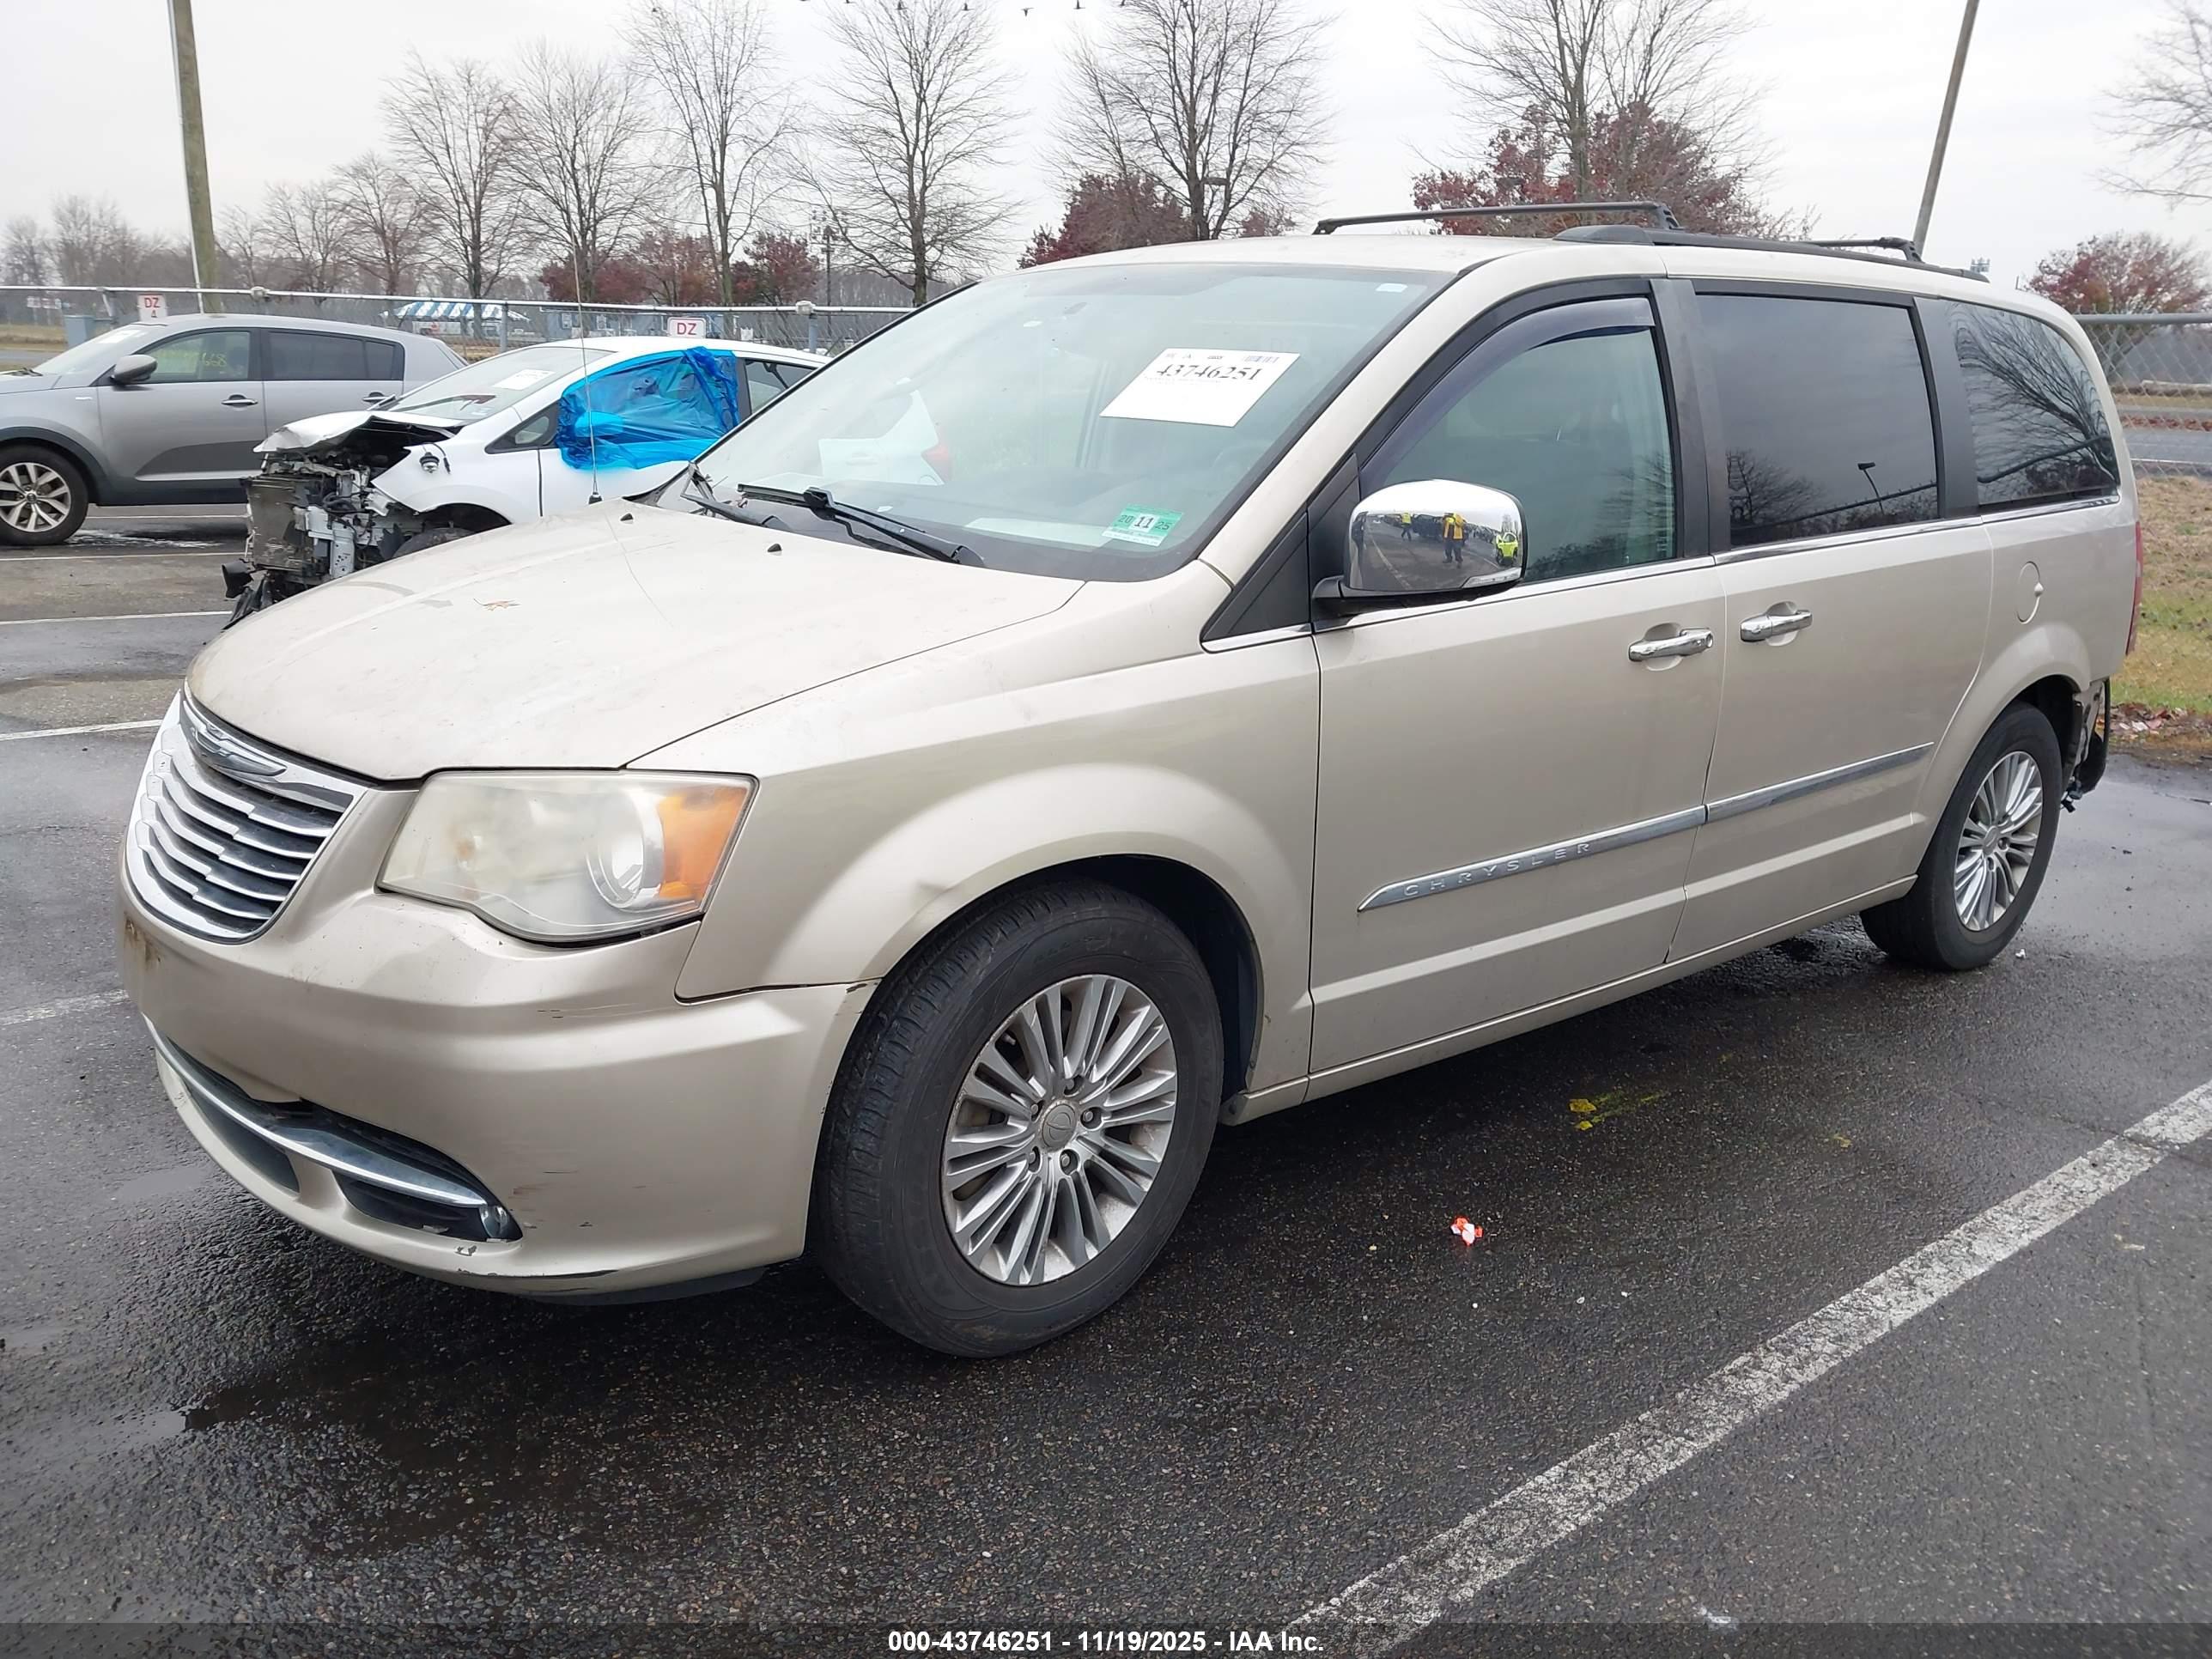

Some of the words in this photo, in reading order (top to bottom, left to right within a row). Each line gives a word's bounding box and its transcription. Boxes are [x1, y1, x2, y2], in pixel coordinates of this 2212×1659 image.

[144, 297, 161, 308] DZ
[677, 322, 697, 336] DZ
[1157, 364, 1263, 380] 43746251
[1118, 514, 1134, 524] 20
[1133, 516, 1154, 529] 11
[1155, 521, 1172, 531] 25
[1402, 842, 1592, 898] CHRYSLER
